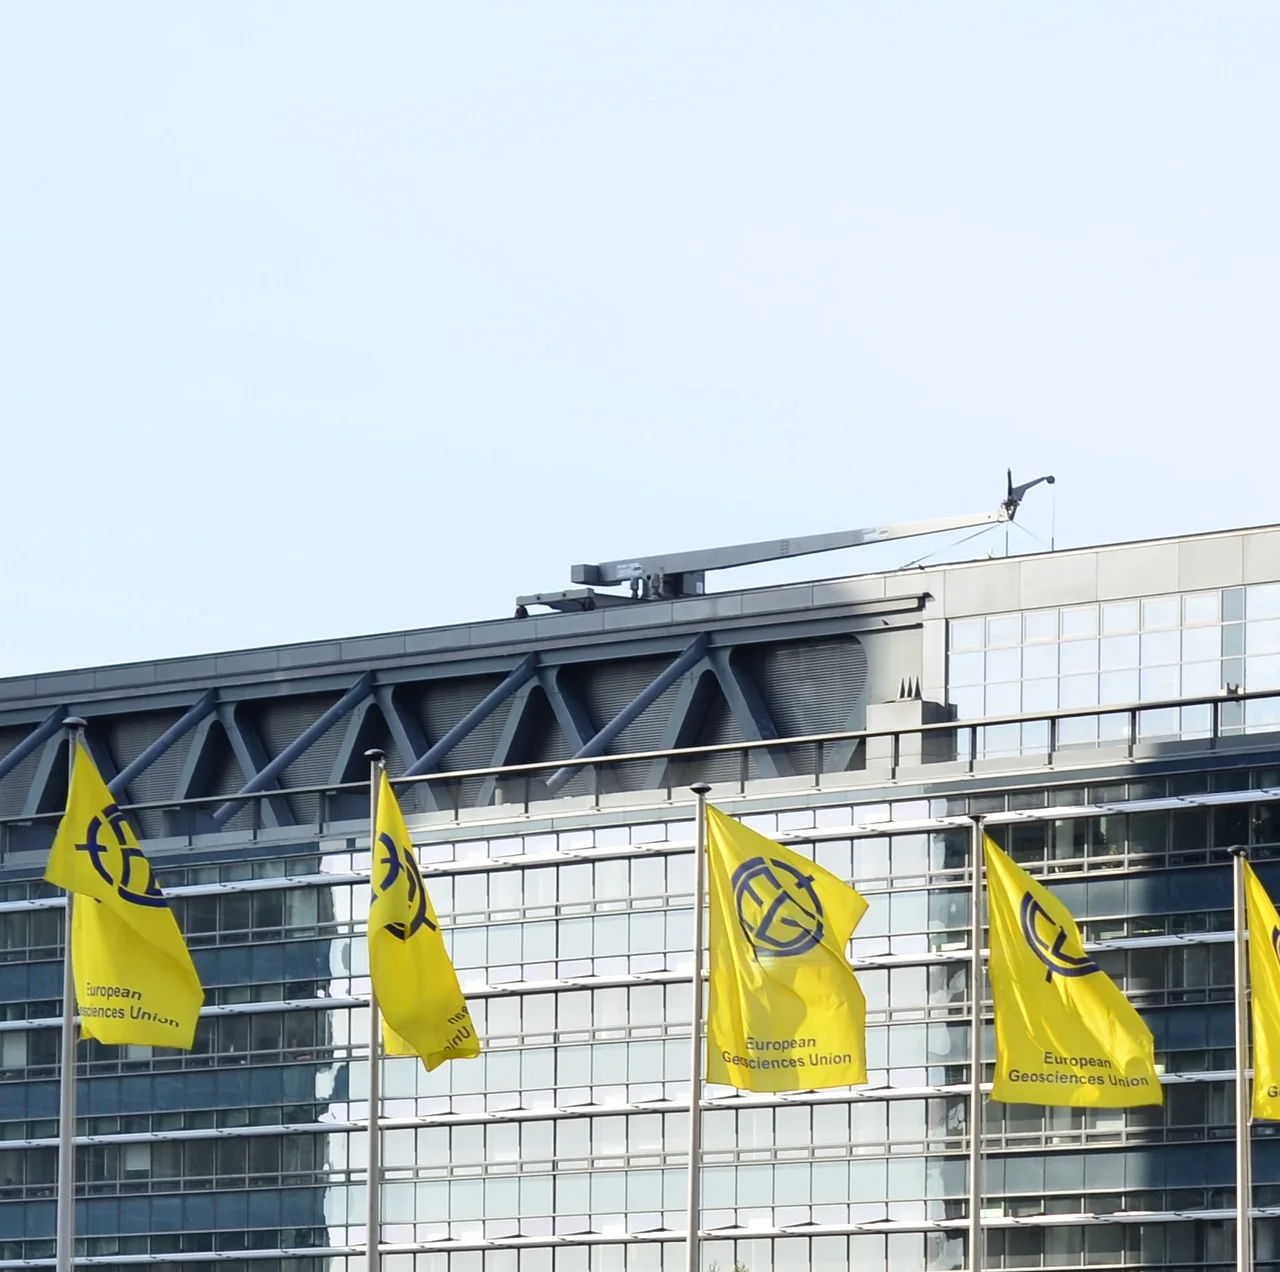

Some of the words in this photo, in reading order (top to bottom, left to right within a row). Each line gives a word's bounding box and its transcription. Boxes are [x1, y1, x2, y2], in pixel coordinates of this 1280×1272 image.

[86, 982, 143, 1001] European
[130, 1005, 180, 1028] Union
[745, 1036, 817, 1053] European
[721, 1050, 806, 1070] Geosciences
[809, 1053, 853, 1067] Union
[1044, 1051, 1112, 1070] European
[1008, 1068, 1105, 1085] Geosciences
[1108, 1074, 1150, 1088] Union
